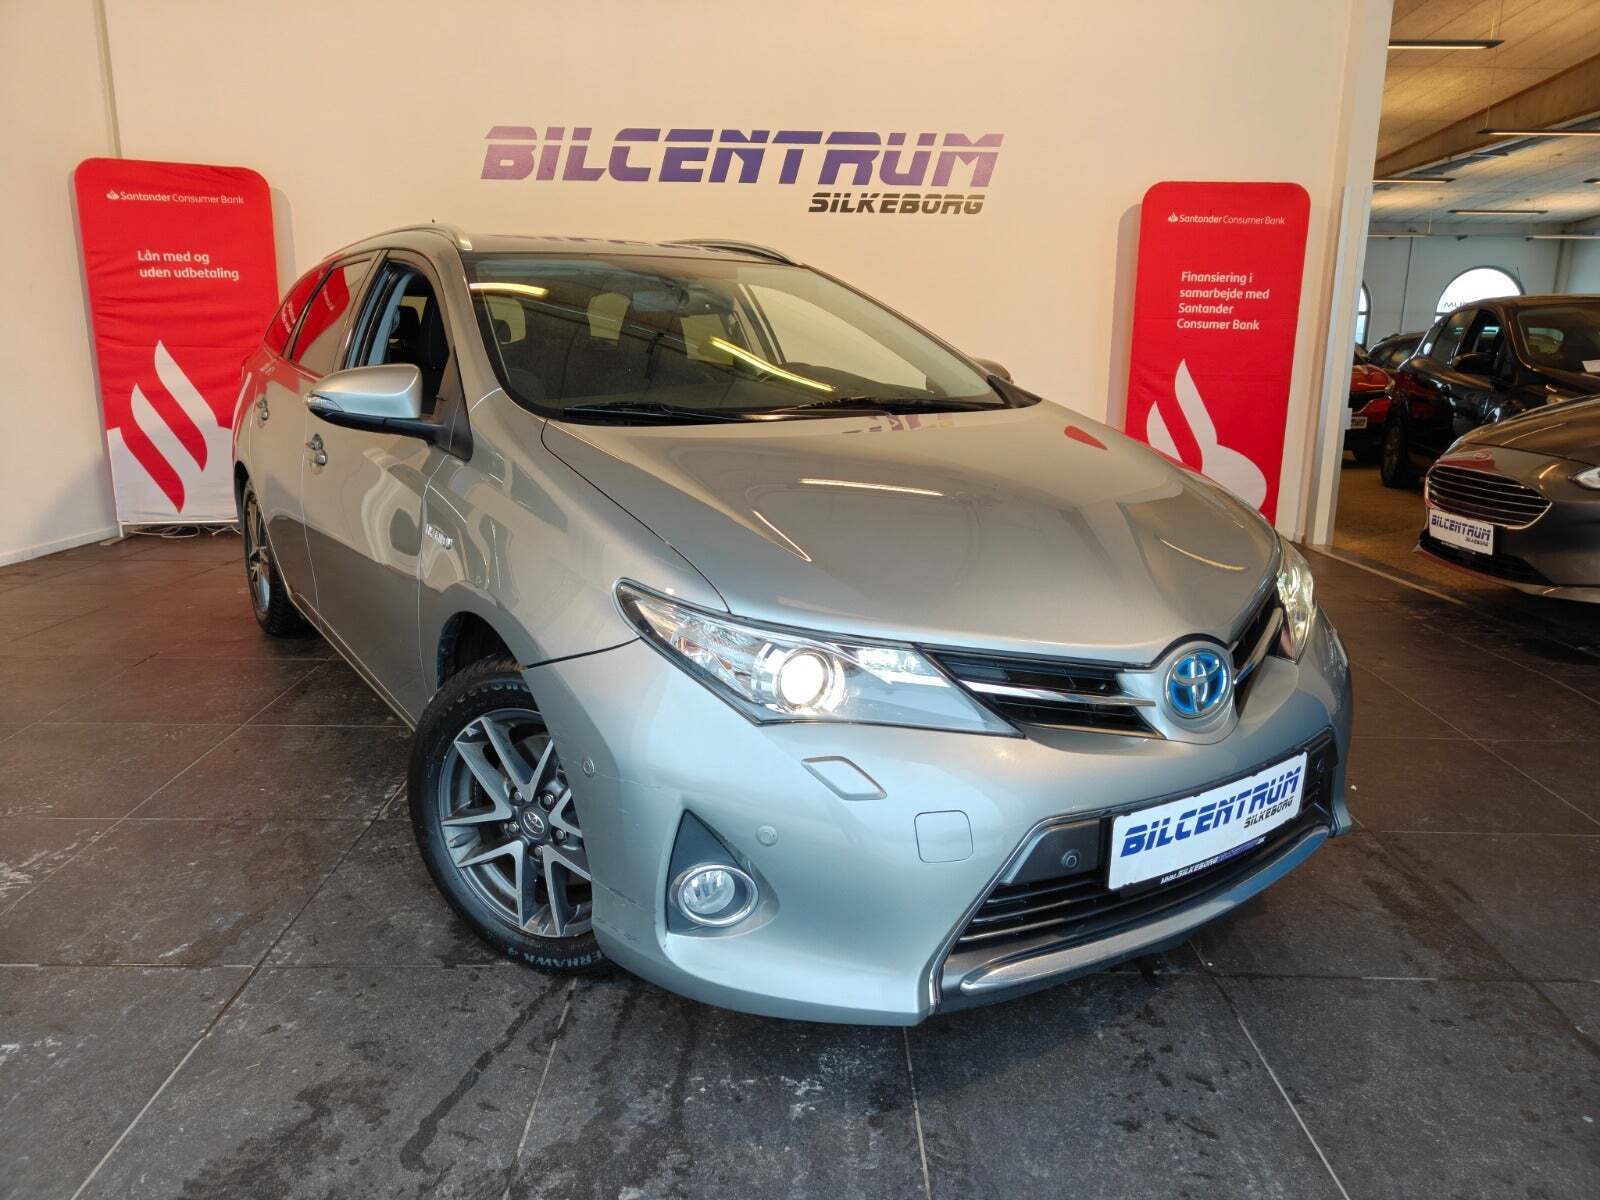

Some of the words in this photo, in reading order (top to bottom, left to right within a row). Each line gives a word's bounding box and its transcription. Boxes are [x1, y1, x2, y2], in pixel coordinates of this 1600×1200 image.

[479, 125, 1005, 188] BILCENTRUM
[120, 191, 171, 202] Santander
[172, 193, 220, 204] Consumer
[221, 195, 244, 205] Bank
[808, 191, 986, 215] SILKEBORG
[1179, 214, 1223, 224] Santander
[1223, 215, 1265, 225] Consumer
[1265, 216, 1285, 225] Bank
[137, 249, 160, 262] Lån
[163, 250, 191, 263] med
[194, 253, 210, 265] og
[140, 266, 171, 278] uden
[174, 266, 240, 282] udbetaling
[1181, 271, 1247, 285] Finansiering
[1179, 288, 1243, 301] samarbejde
[1245, 289, 1270, 300] med
[1178, 303, 1234, 314] Santander
[1177, 318, 1230, 330] Consumer
[1232, 319, 1260, 330] Bank
[1431, 514, 1492, 542] BILCENTRUM
[1120, 765, 1302, 858] BILCENTRUM
[1243, 795, 1295, 829] SILKEBORG
